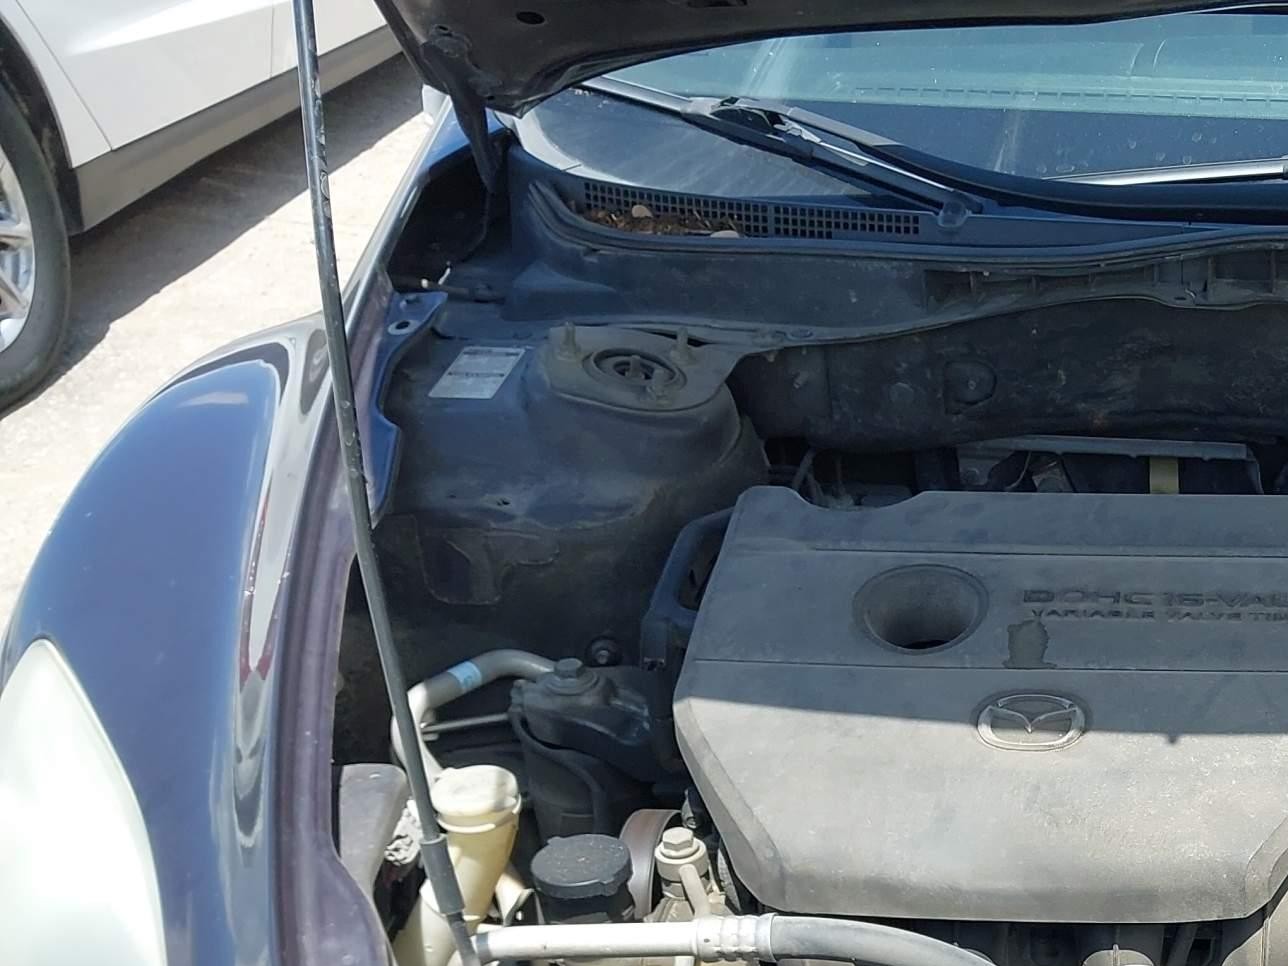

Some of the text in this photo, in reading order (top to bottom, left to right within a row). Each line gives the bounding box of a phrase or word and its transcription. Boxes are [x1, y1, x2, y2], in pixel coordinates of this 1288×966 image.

[1023, 588, 1153, 605] DOHC
[1030, 608, 1155, 620] VARIABLE
[1167, 610, 1243, 622] VALVE
